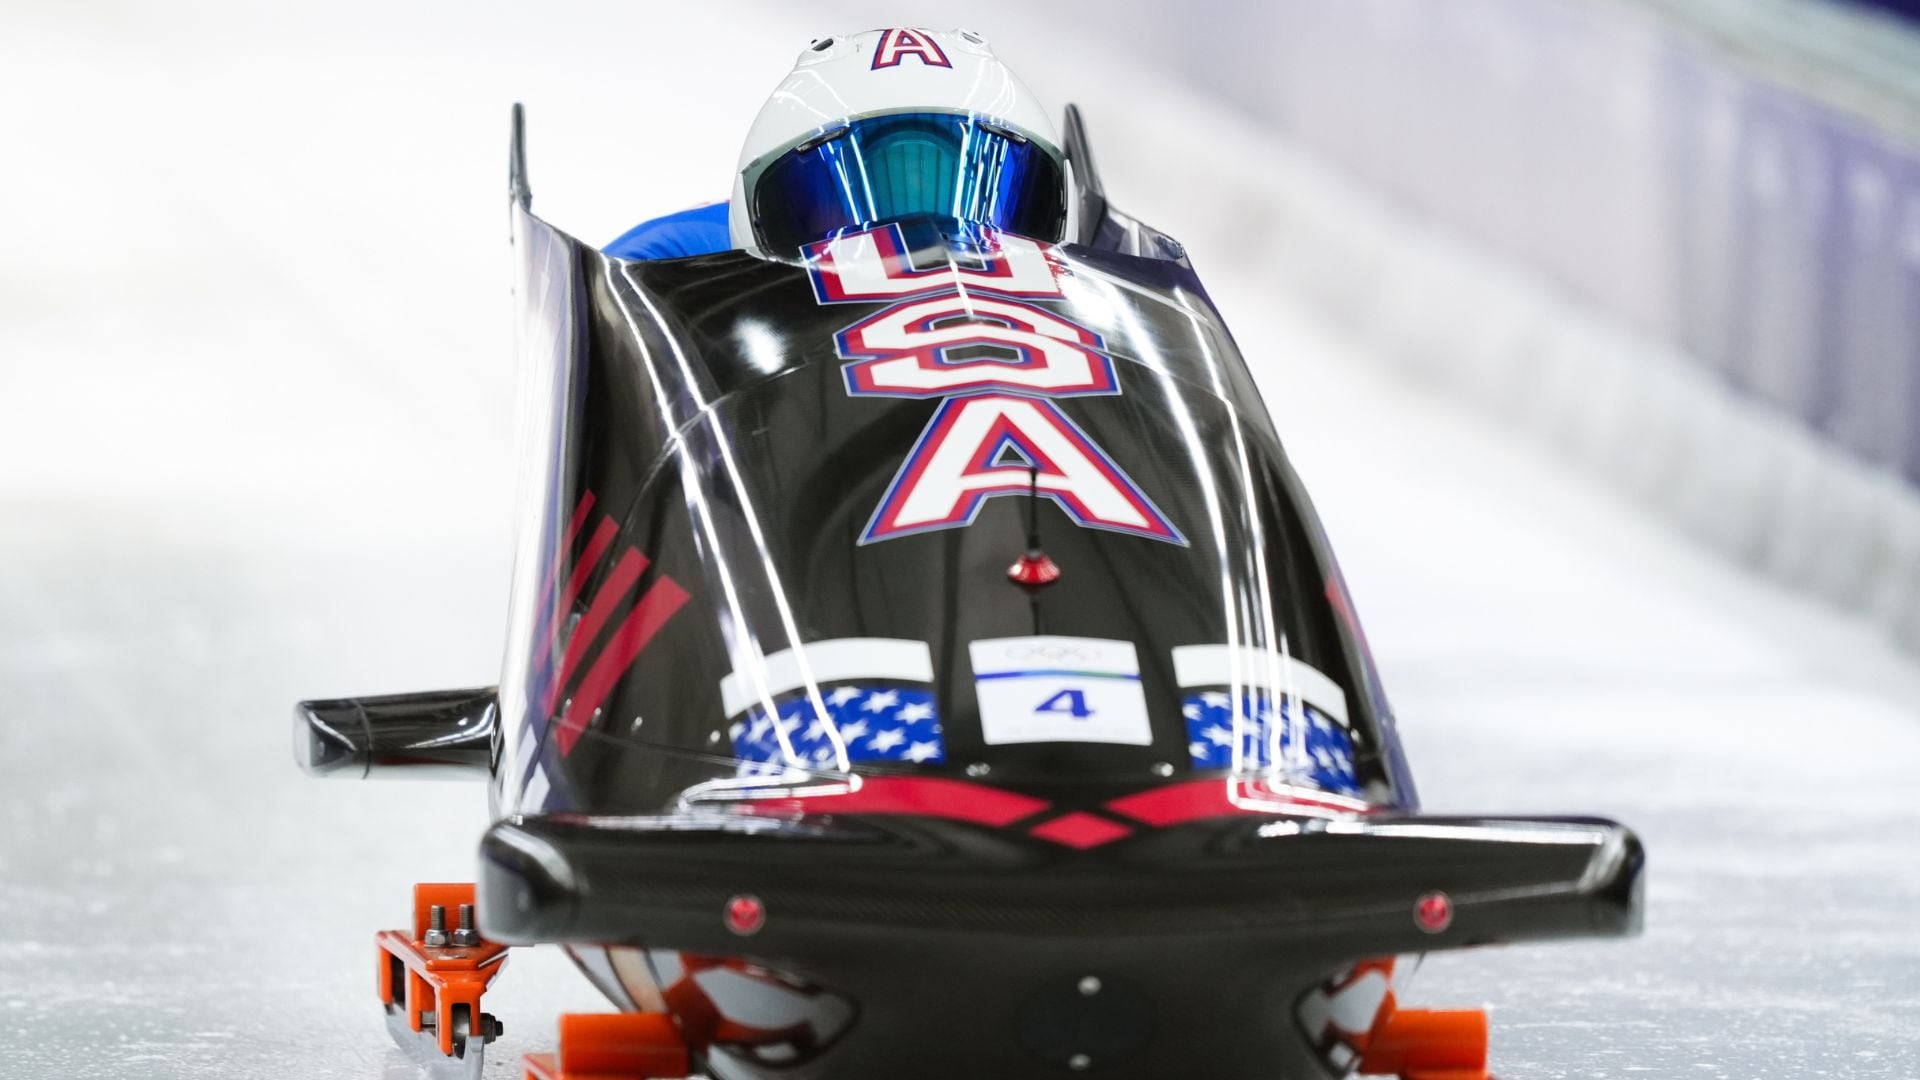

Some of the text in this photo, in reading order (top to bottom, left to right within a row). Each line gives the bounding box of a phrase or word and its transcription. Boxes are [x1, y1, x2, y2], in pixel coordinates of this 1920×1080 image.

[870, 28, 953, 71] A
[799, 222, 1190, 547] USA
[1034, 689, 1095, 718] 4
